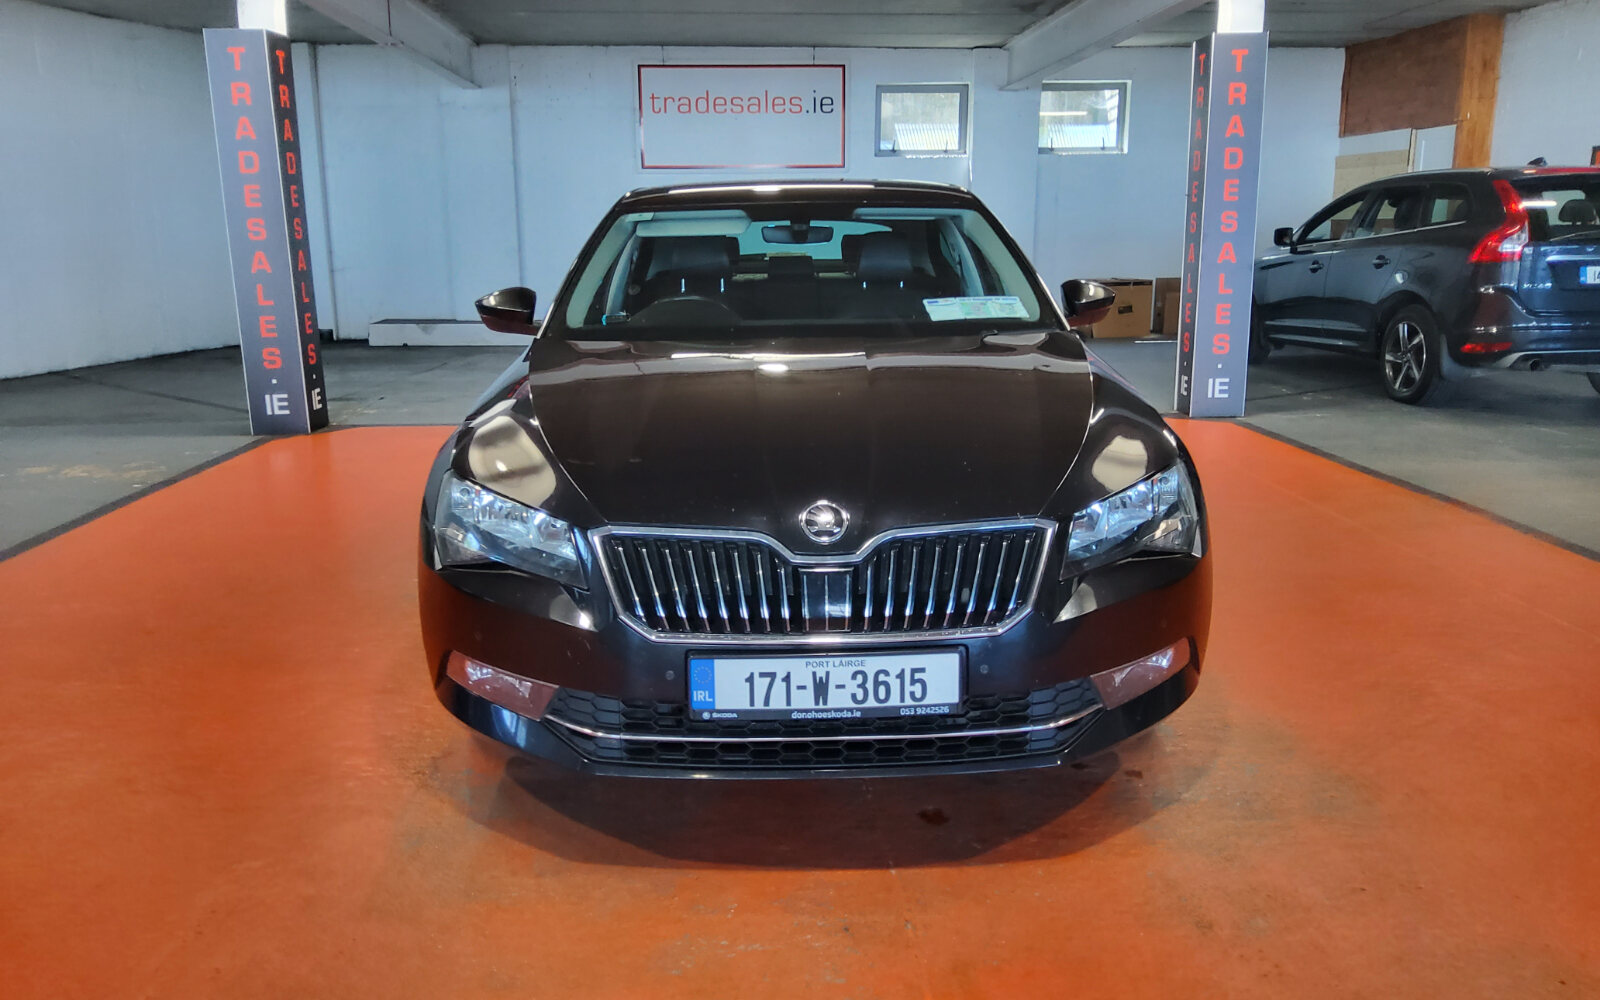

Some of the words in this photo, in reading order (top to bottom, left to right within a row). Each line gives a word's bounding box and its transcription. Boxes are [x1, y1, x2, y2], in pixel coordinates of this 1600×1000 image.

[649, 89, 834, 114] tradesales.ie
[805, 660, 830, 669] PORT
[832, 659, 866, 668] LÁIRGE
[744, 667, 928, 707] 171-W-3615
[693, 690, 713, 702] IRL
[791, 709, 862, 720] donohoeskoda.ie
[900, 707, 915, 716] 053
[916, 705, 950, 715] 9242526
